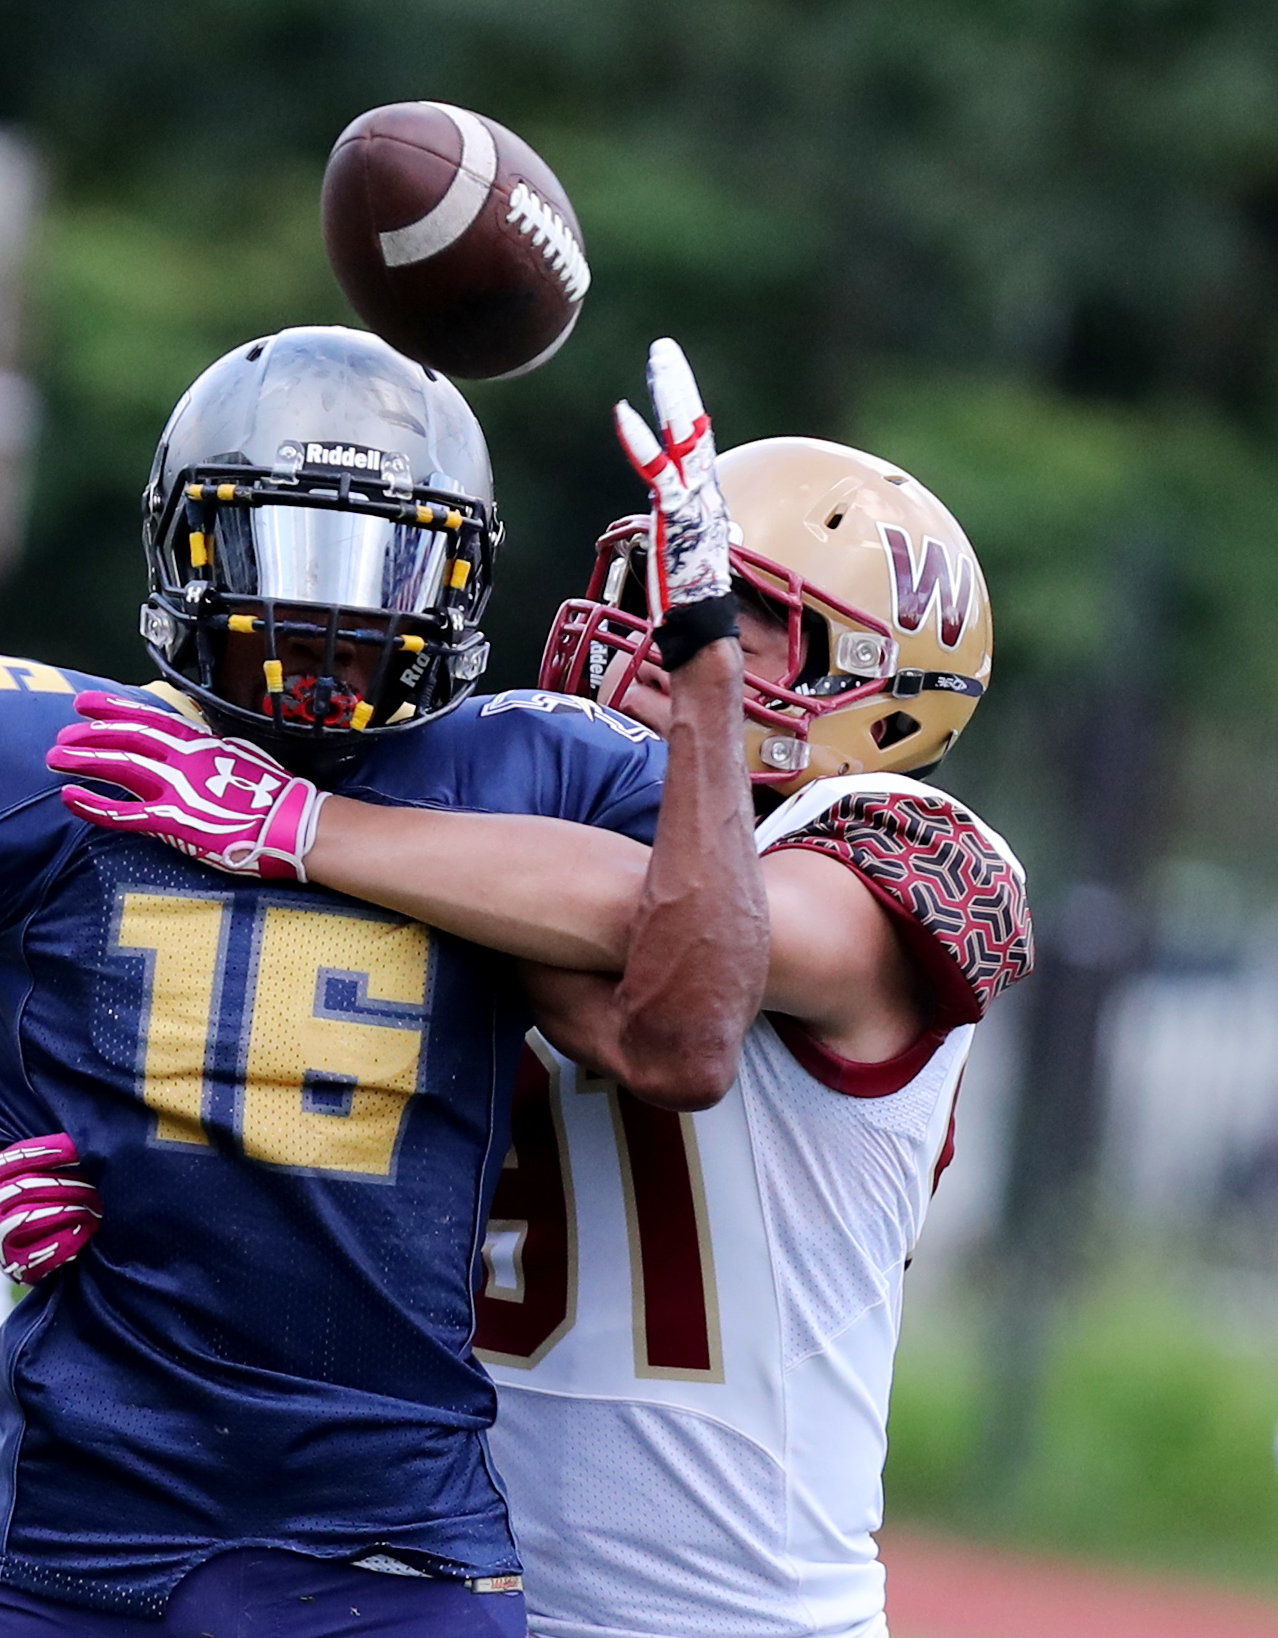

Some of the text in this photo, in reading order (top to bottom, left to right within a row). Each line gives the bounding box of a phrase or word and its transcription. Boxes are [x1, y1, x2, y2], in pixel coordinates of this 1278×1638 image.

[306, 443, 381, 471] Riddell
[876, 521, 975, 652] W
[110, 885, 437, 1184] 16
